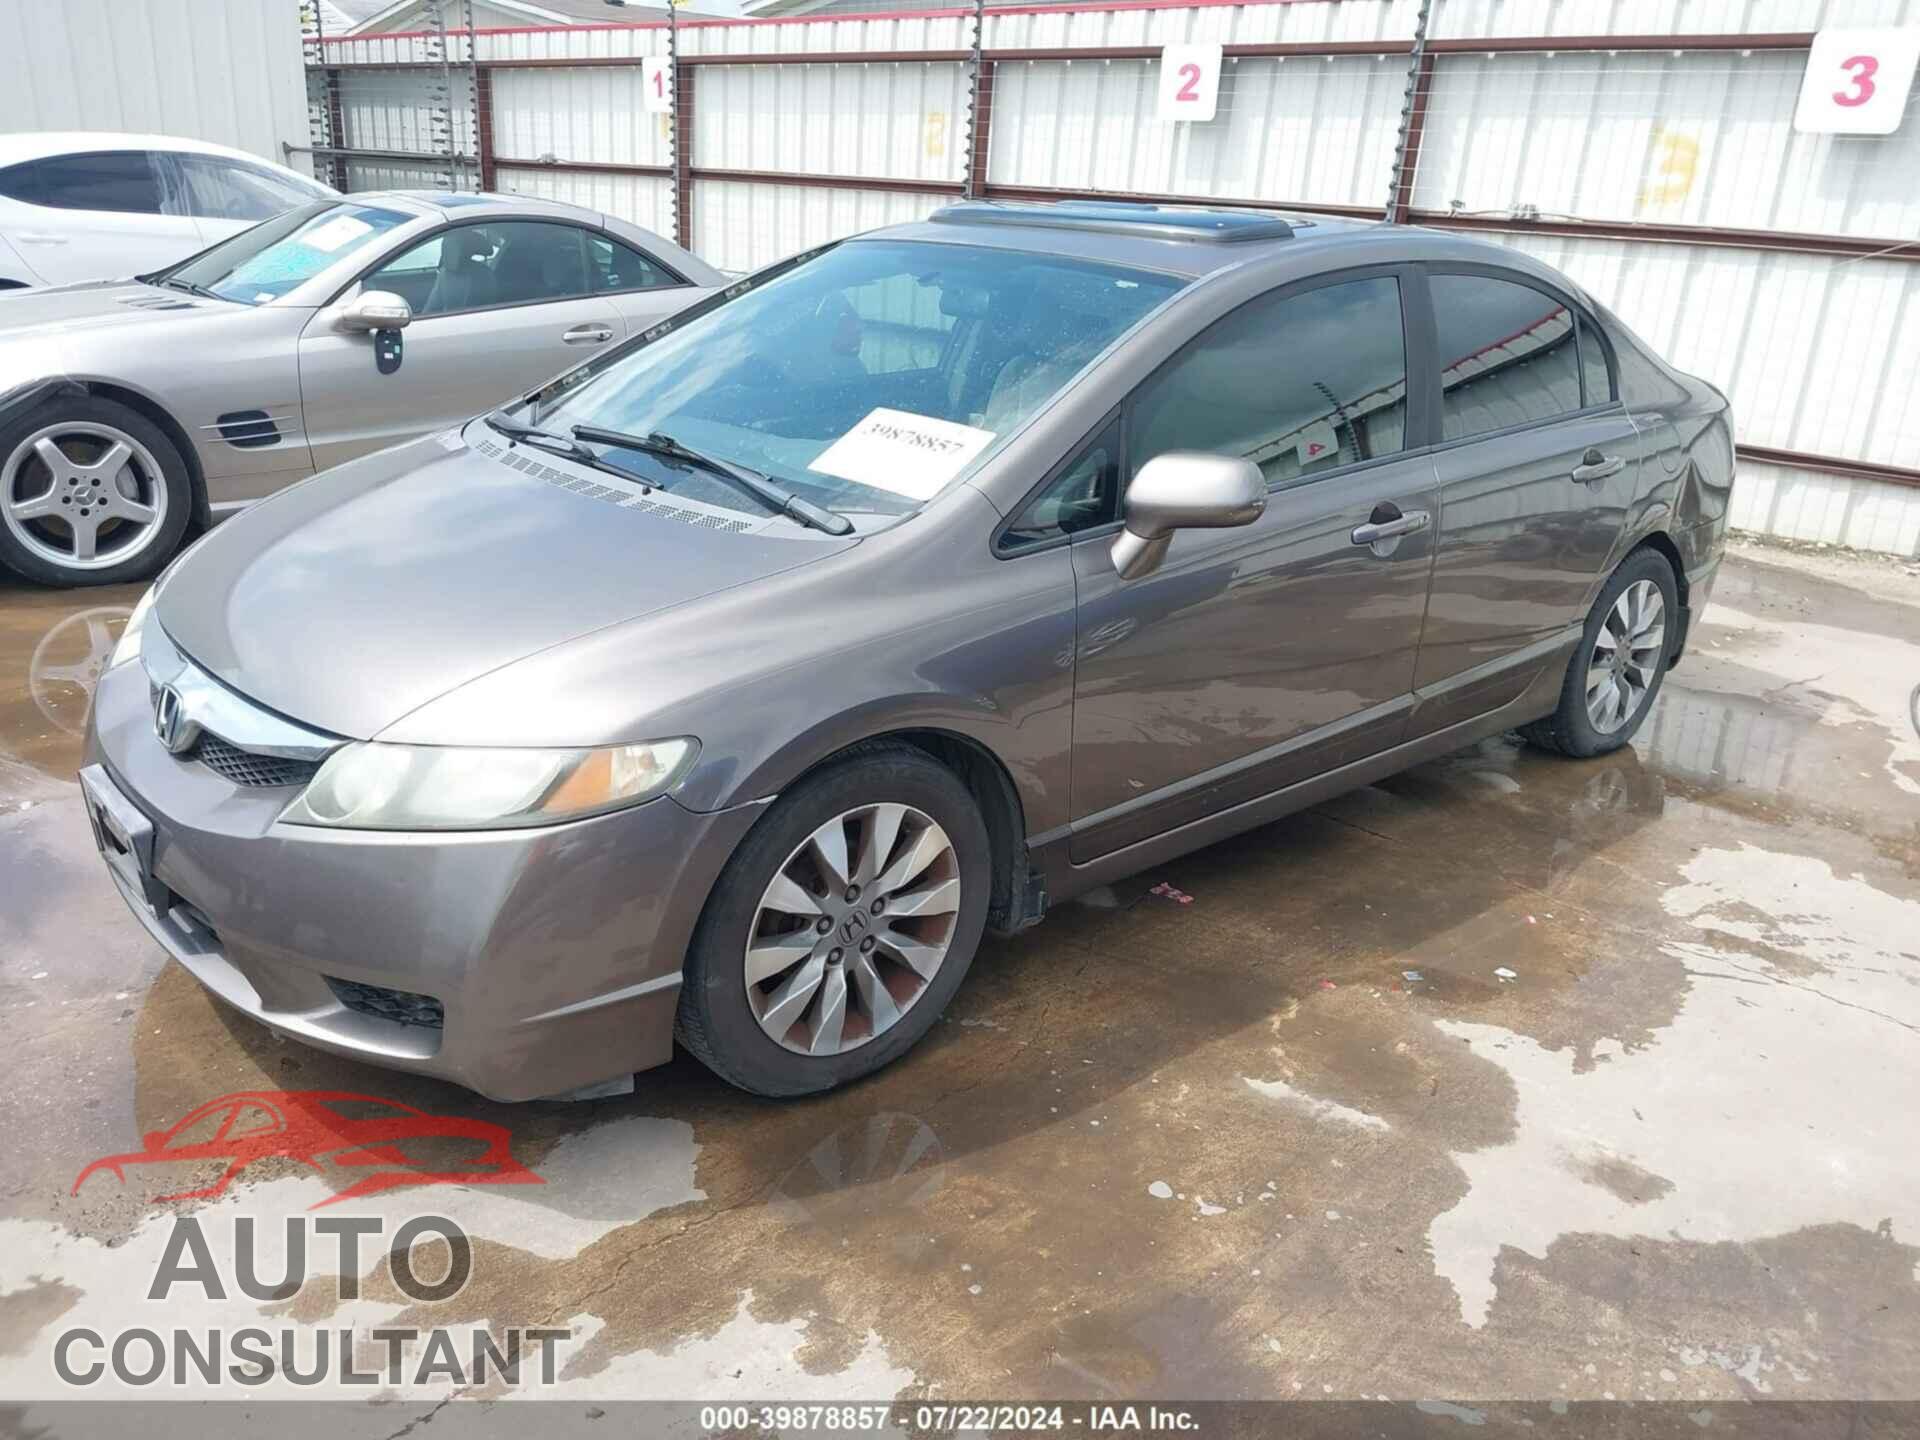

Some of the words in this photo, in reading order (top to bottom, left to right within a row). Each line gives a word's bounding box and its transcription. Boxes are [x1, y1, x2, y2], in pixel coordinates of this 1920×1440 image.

[654, 70, 662, 98] 1
[1176, 63, 1201, 101] 2
[1832, 55, 1879, 107] 3
